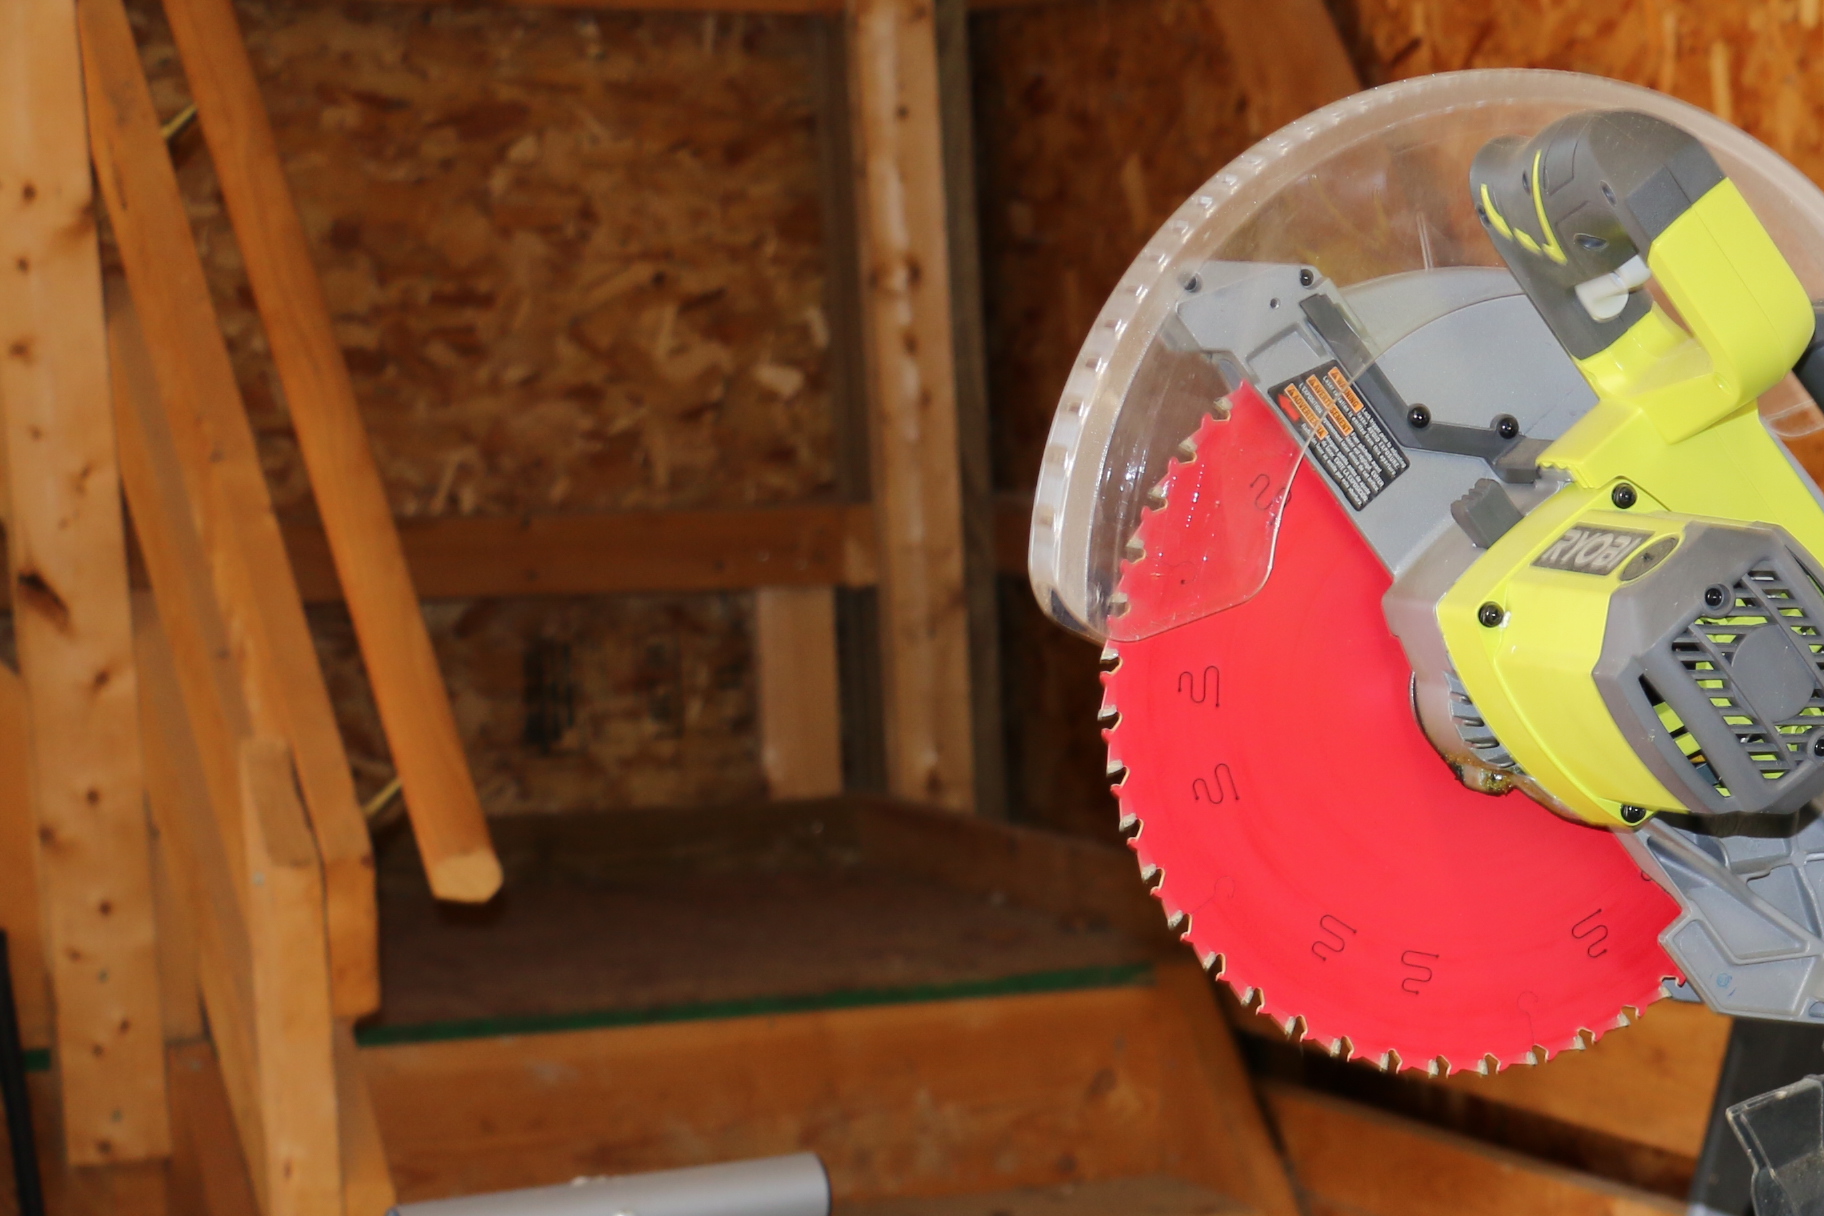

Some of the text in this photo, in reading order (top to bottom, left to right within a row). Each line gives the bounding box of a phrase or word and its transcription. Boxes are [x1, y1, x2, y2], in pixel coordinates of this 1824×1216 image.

[1313, 383, 1351, 433] AVERTISEMENT
[1336, 377, 1359, 407] WANING
[1541, 528, 1642, 569] RYOBI
